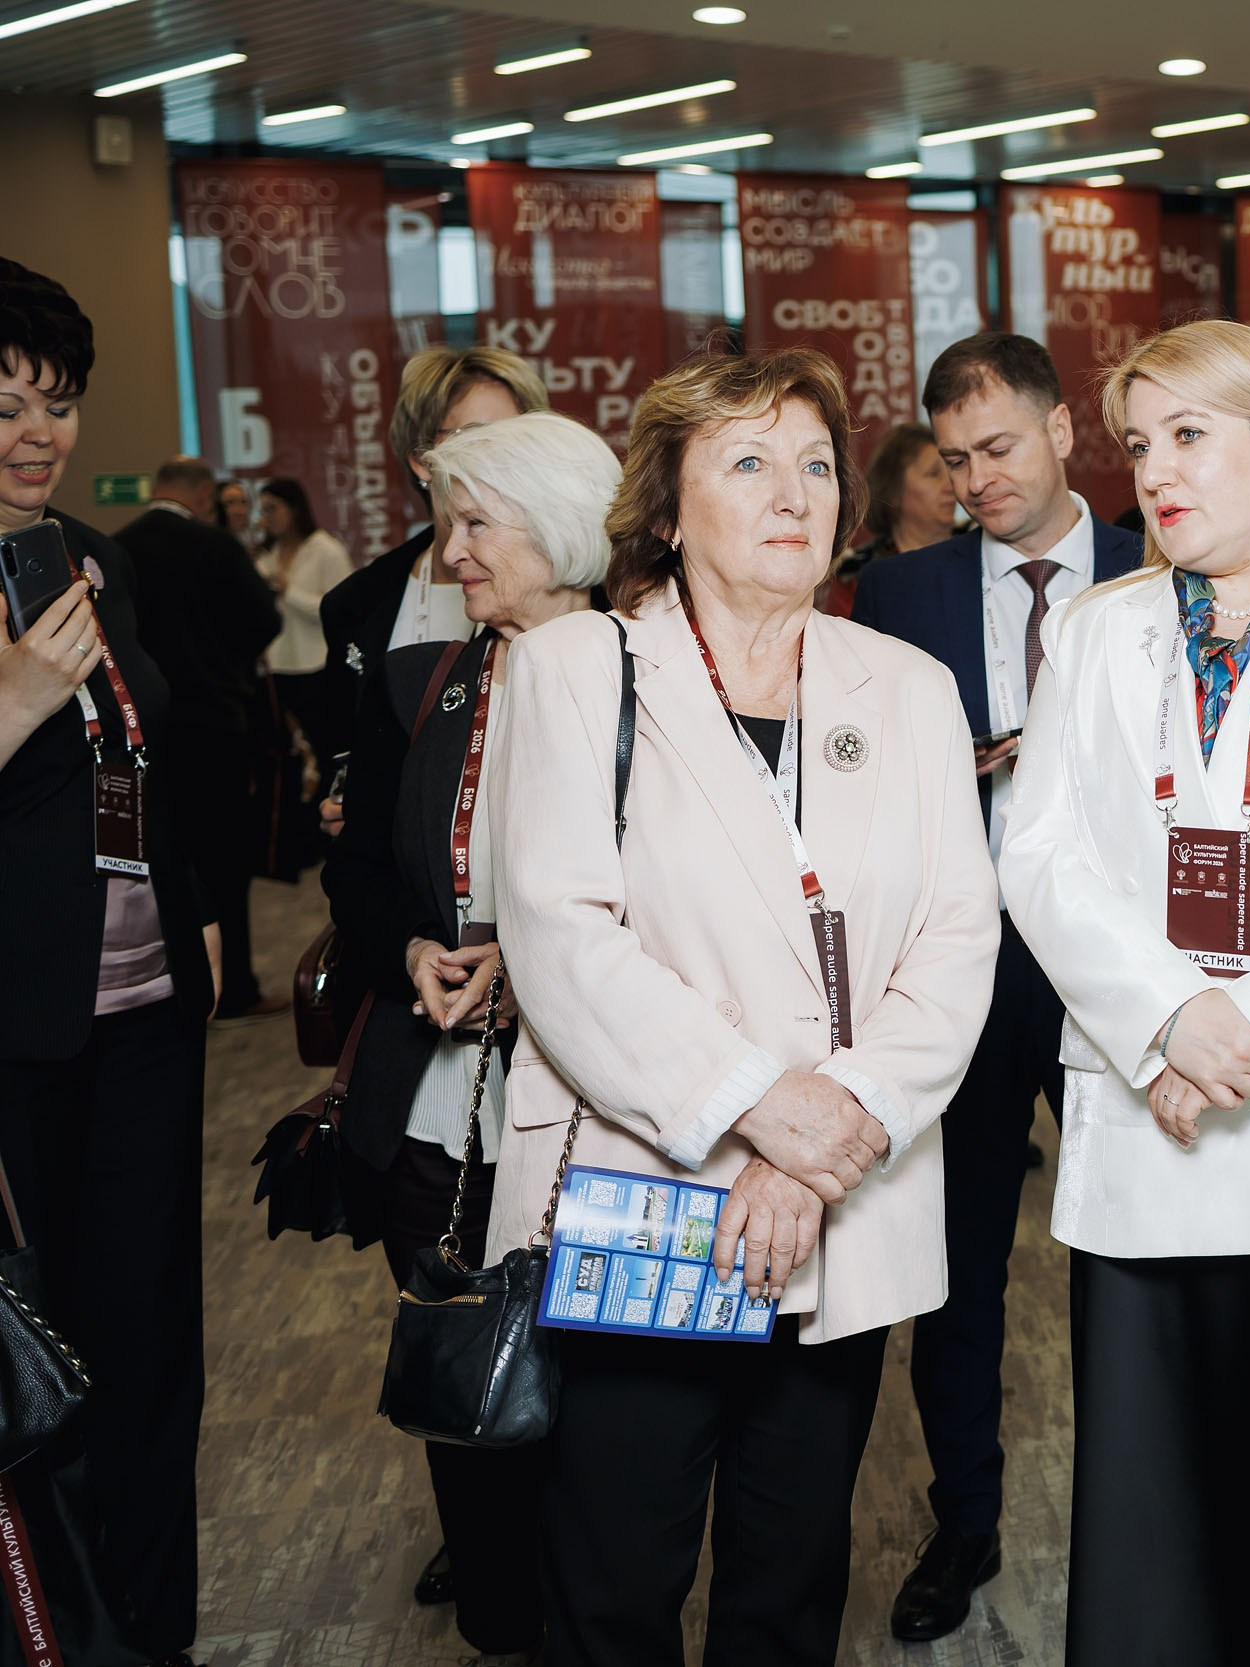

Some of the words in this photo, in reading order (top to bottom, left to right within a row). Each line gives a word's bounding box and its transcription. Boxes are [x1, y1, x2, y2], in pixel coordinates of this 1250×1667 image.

[514, 202, 650, 234] ДИАЛОГ
[486, 318, 556, 353] КУ
[535, 355, 636, 393] ЬТУ
[1160, 698, 1170, 718] aude
[470, 729, 484, 754] 2026
[1159, 720, 1168, 750] sapere
[461, 788, 475, 811] БКФ
[455, 847, 467, 875] БКФ
[1239, 833, 1247, 865] sapere
[103, 858, 143, 871] УЧАСТНИК
[1239, 867, 1247, 891] aude
[1237, 893, 1245, 925] sapere
[1237, 926, 1245, 951] aude
[827, 954, 837, 983] aude
[1185, 952, 1244, 968] АСТНИК
[829, 986, 840, 1024] sapere
[831, 1027, 841, 1053] aud
[8, 1558, 47, 1652] БАЛТИЙСКИЙ
